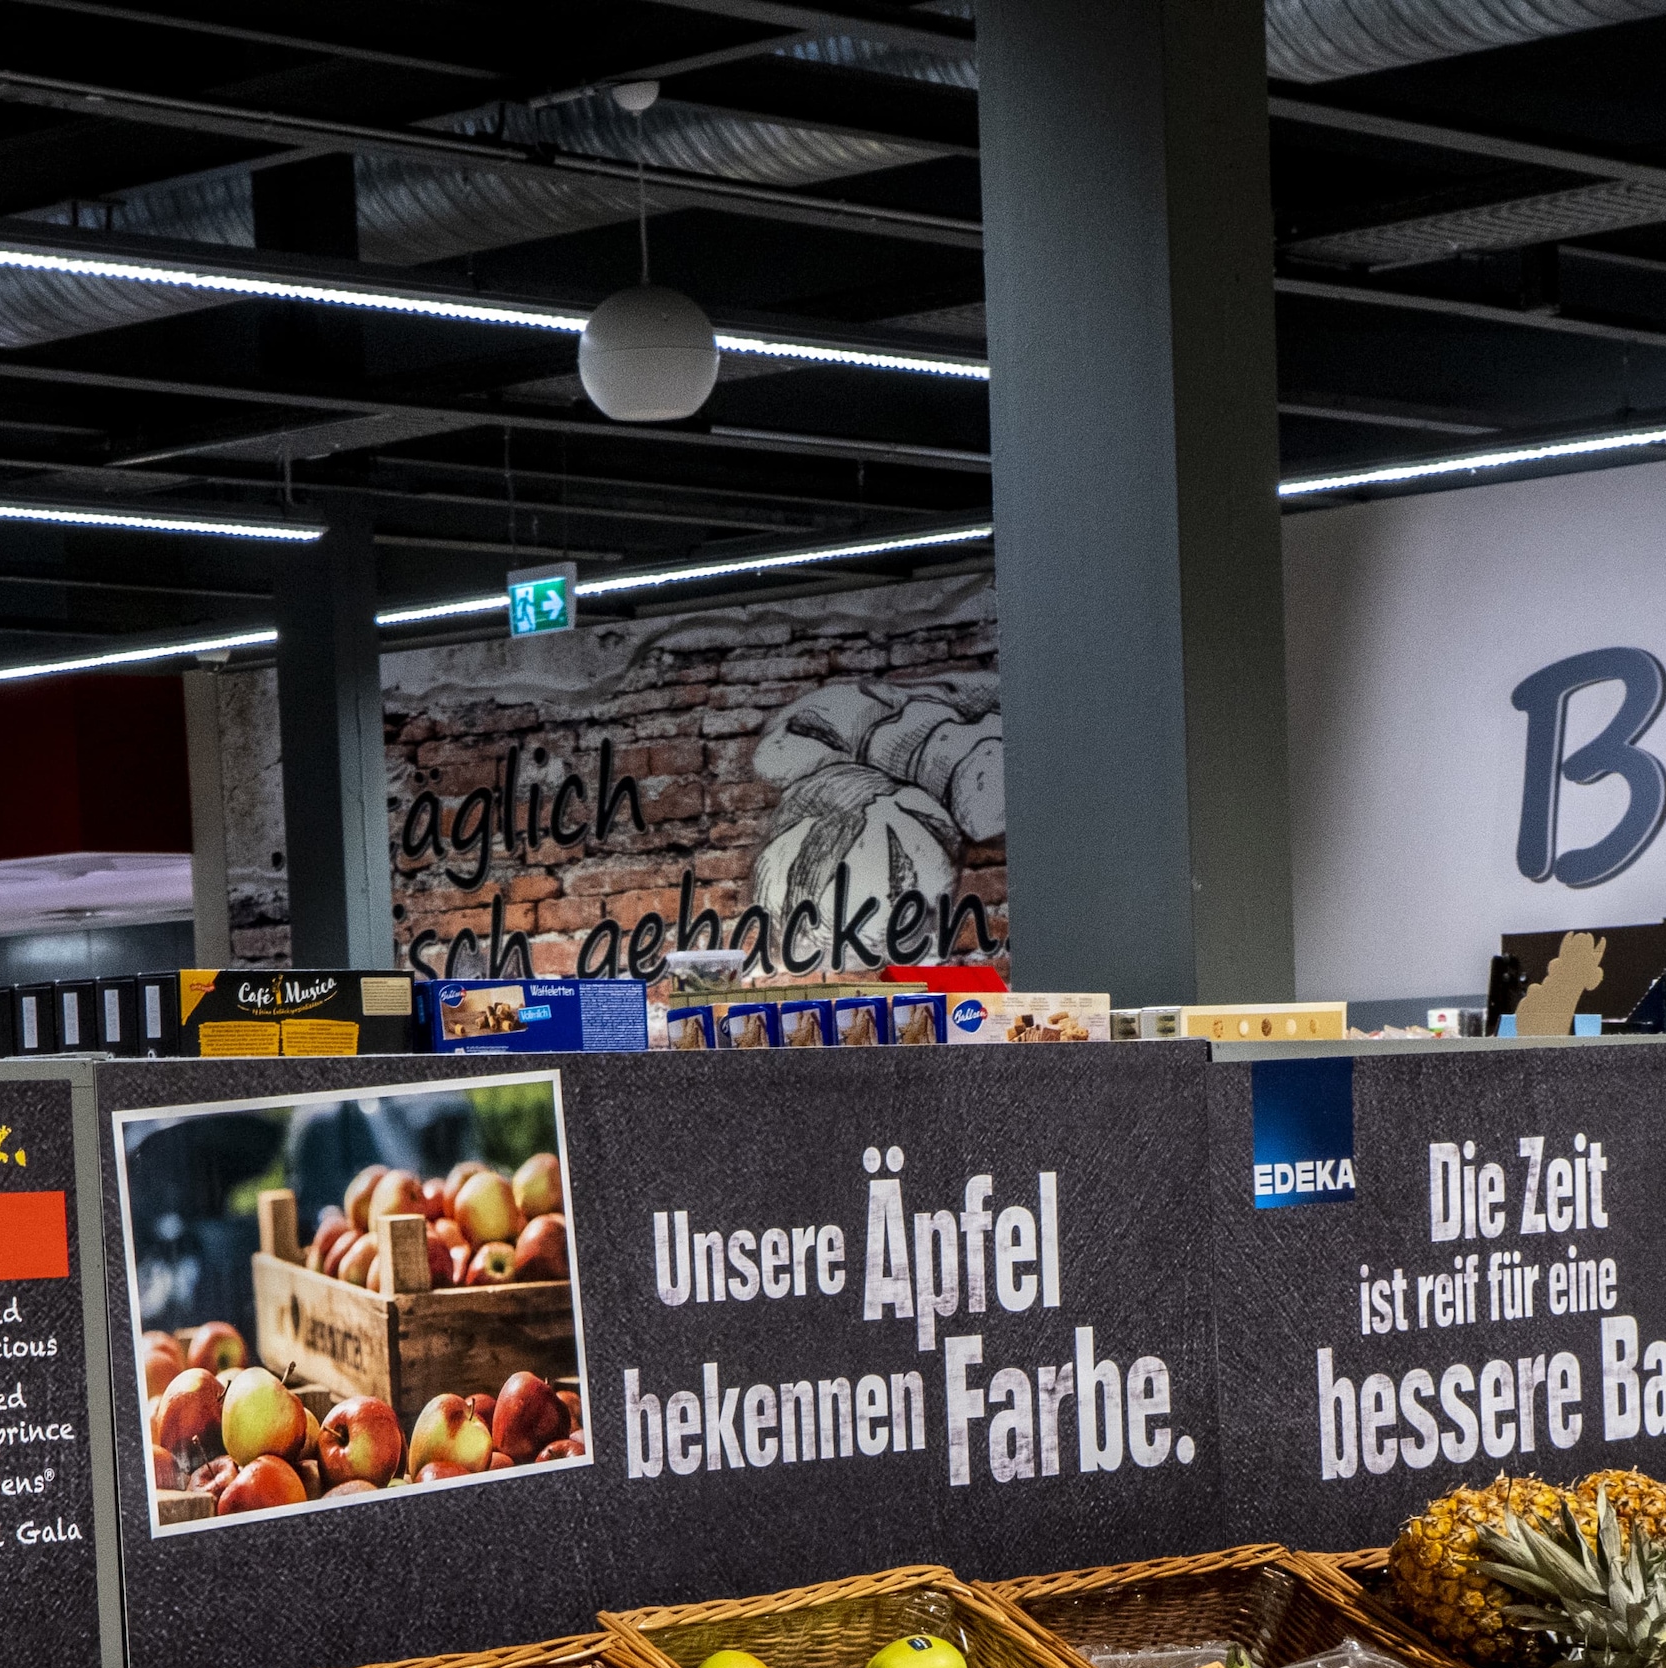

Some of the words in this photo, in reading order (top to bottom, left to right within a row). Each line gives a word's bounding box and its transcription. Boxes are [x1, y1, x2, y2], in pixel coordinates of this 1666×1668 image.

[385, 739, 647, 891] äglich
[238, 982, 274, 1008] Café
[284, 977, 337, 1005] Musica
[1252, 1157, 1357, 1196] EDEKA
[1429, 1141, 1506, 1243] Die
[1518, 1131, 1610, 1236] Zeit
[652, 1209, 847, 1307] Unsere
[860, 1144, 1062, 1352] Äpfel
[1359, 1263, 1409, 1336] ist
[1417, 1254, 1478, 1330] reif
[1486, 1249, 1540, 1325] für
[1547, 1245, 1619, 1317] eine
[623, 1361, 927, 1480] bekennen
[943, 1325, 1197, 1487] Farbe.
[1316, 1346, 1583, 1482] bessere
[15, 1517, 83, 1547] Gala
